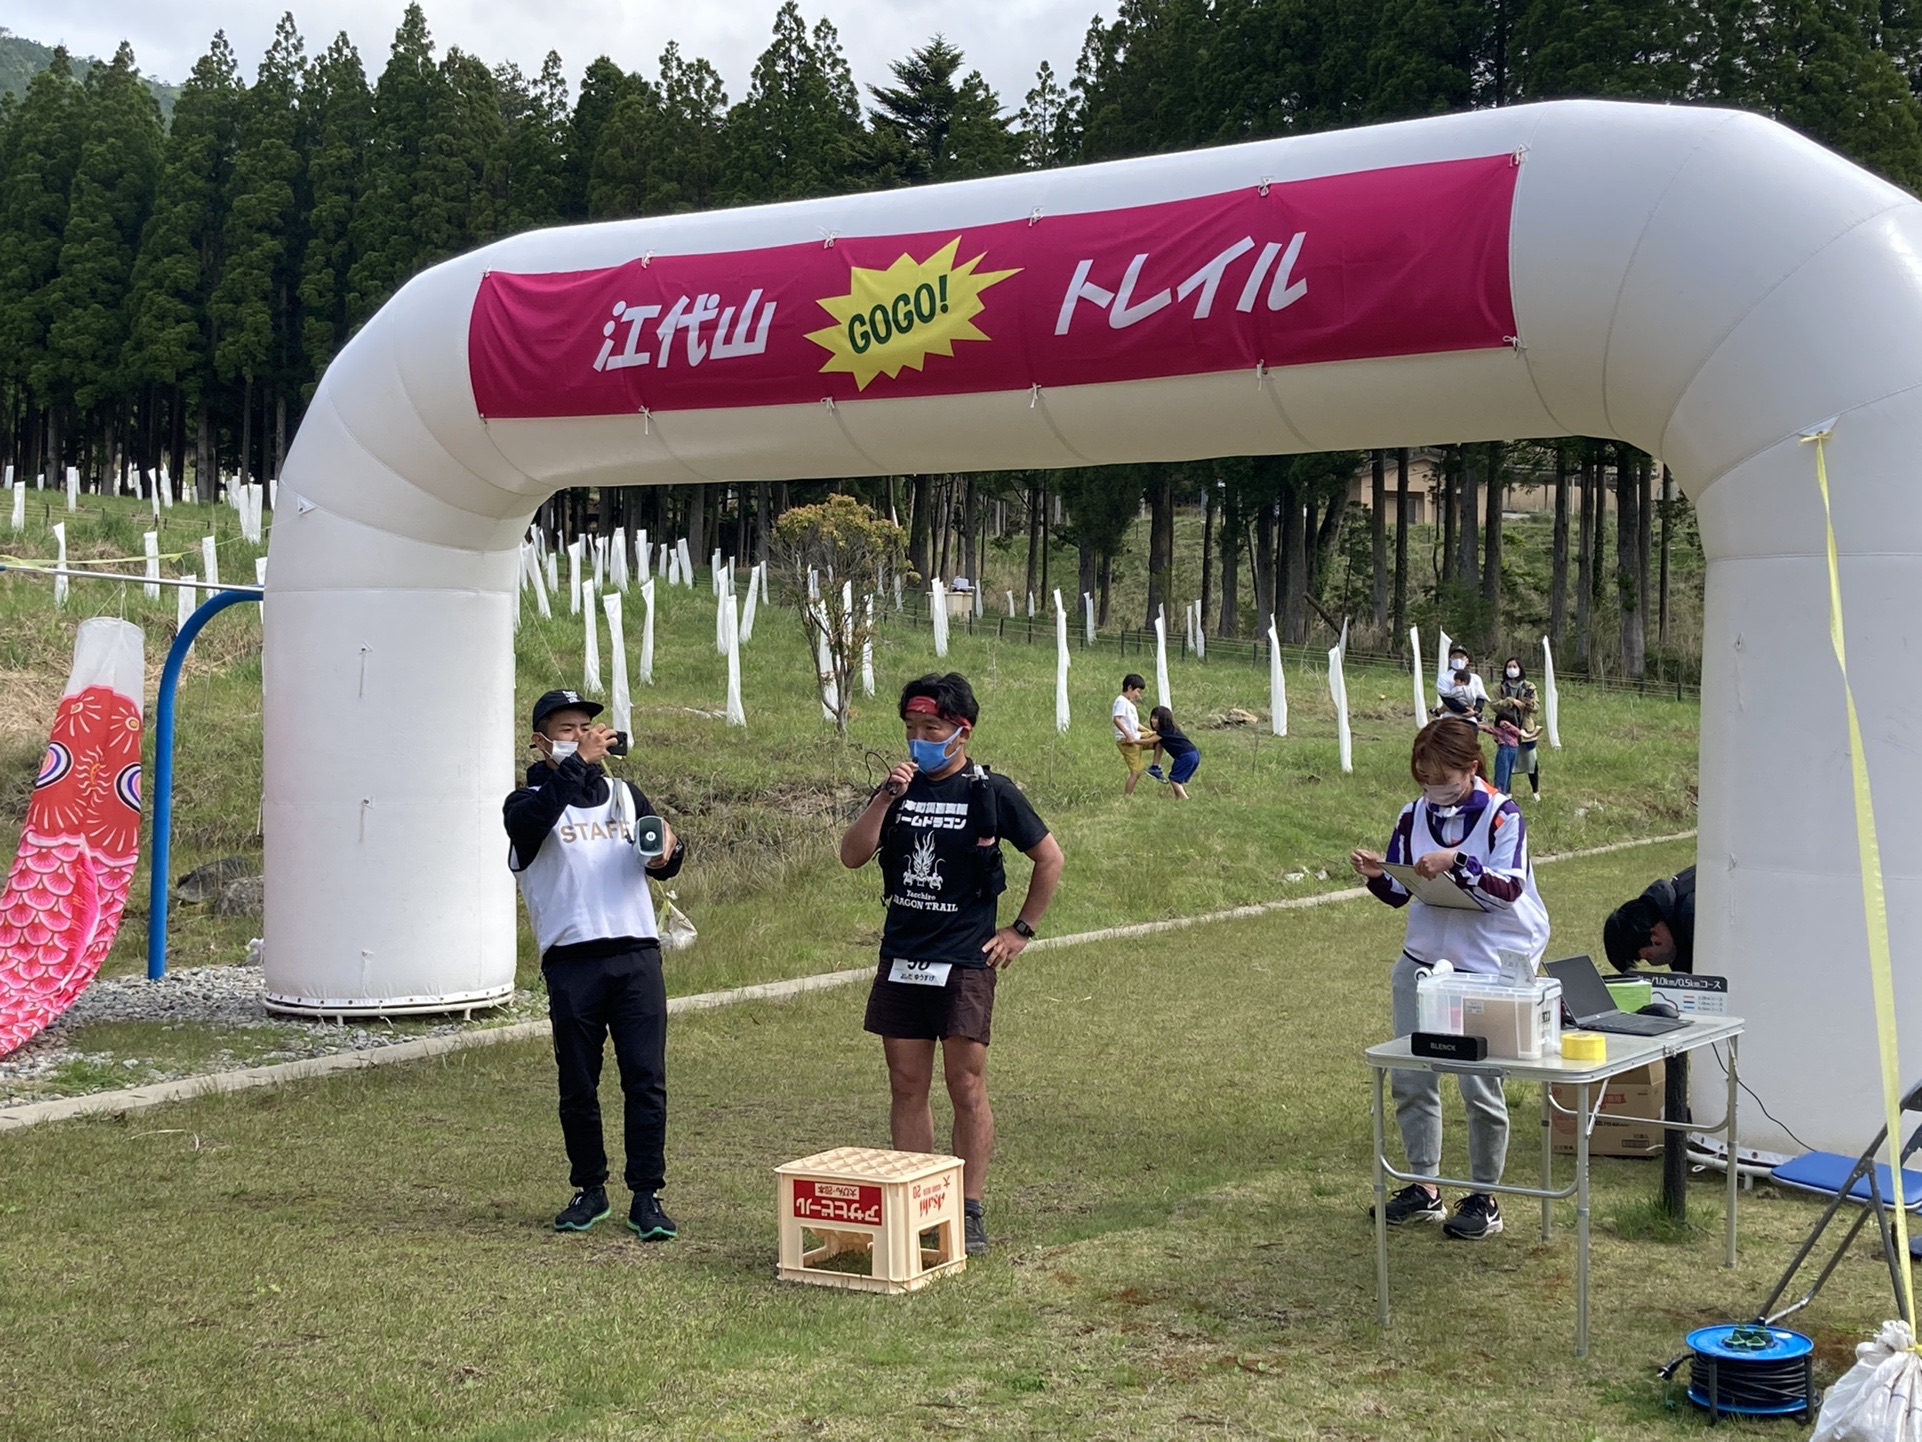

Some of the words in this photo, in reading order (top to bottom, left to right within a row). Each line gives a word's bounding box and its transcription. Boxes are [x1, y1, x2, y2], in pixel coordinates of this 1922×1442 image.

[593, 288, 777, 373] 江代山
[847, 274, 950, 355] GOGO!
[1054, 231, 1308, 336] トレイル
[560, 820, 631, 844] STAFF
[906, 889, 937, 901] Yacchiro
[925, 901, 959, 913] TRAIL
[796, 1197, 880, 1223] アサヒビール
[919, 1192, 946, 1218] Asahi
